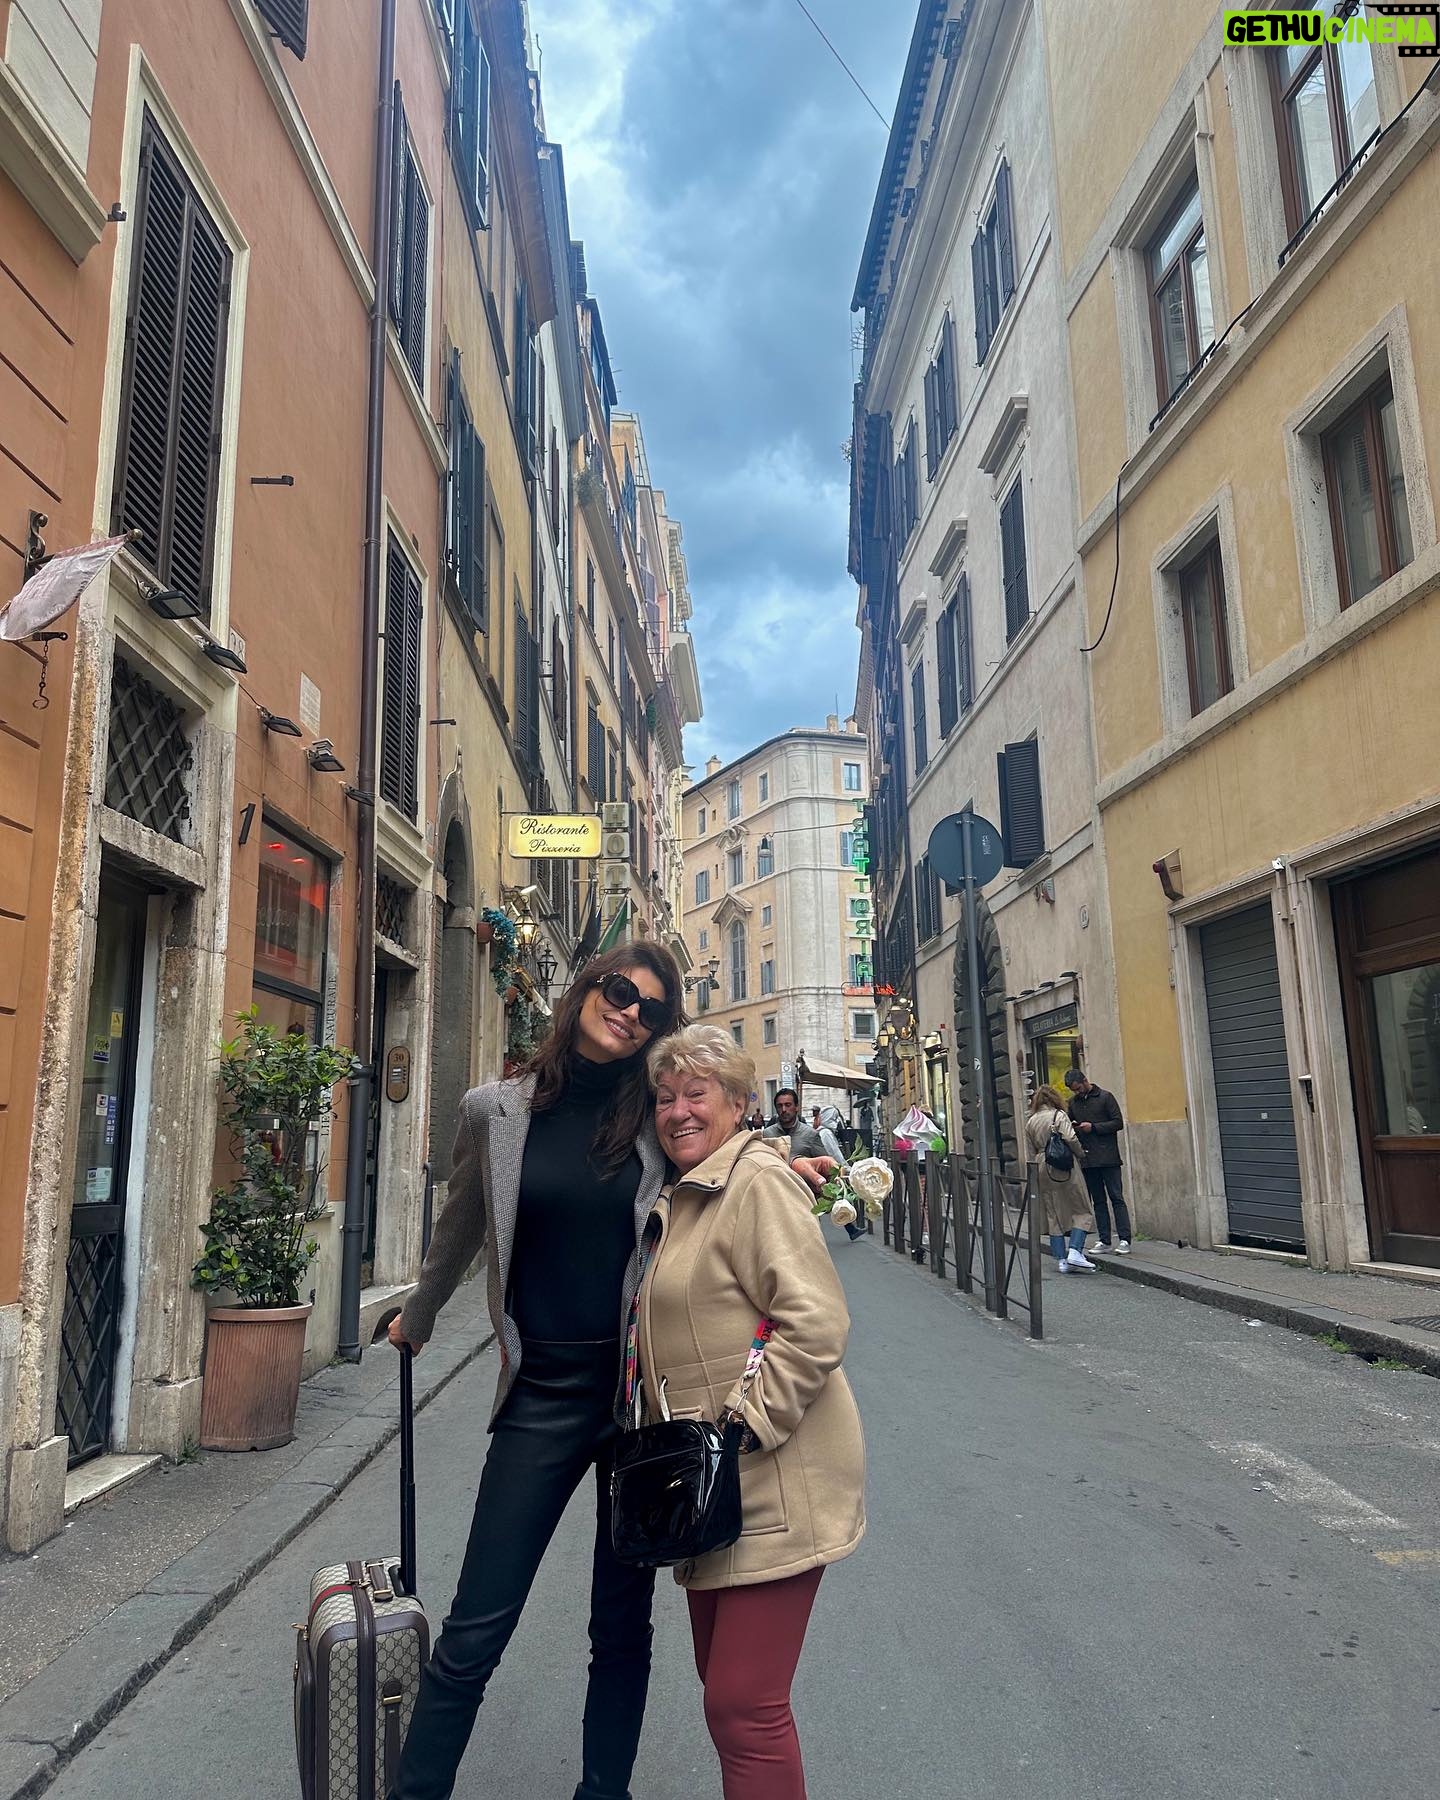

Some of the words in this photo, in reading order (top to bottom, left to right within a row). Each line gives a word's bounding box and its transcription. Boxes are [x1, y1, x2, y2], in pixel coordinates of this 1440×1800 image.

[519, 817, 590, 836] Ristorante
[528, 838, 581, 853] Pizzeria
[326, 976, 338, 1041] NATURALE
